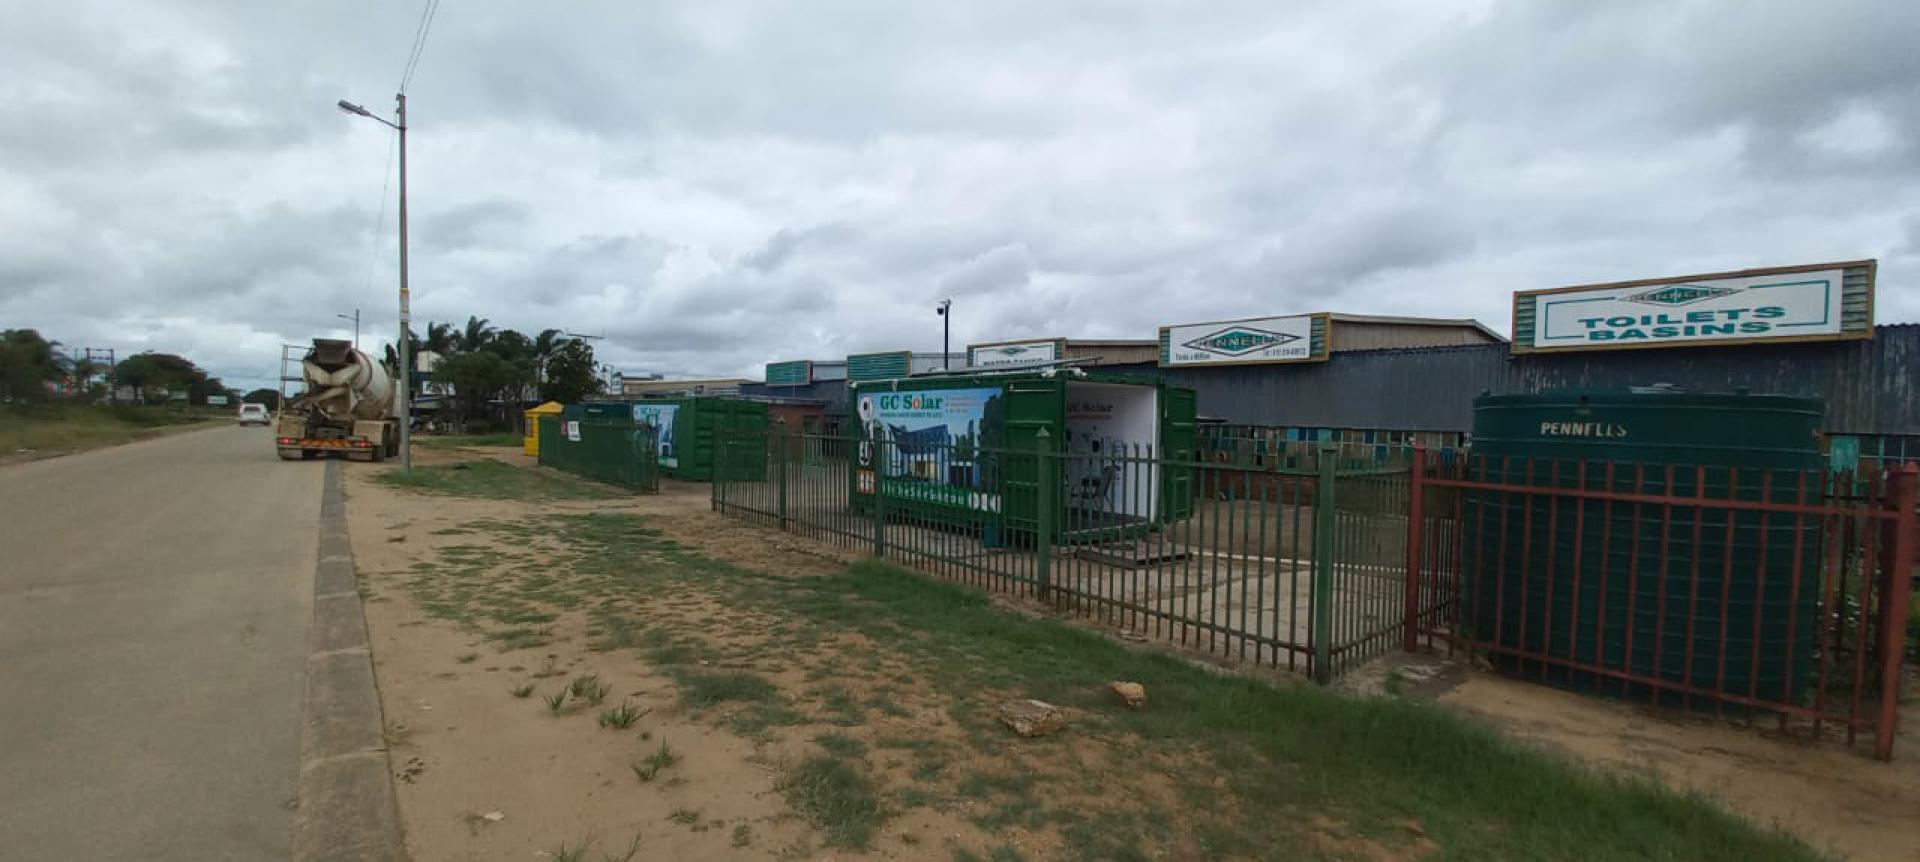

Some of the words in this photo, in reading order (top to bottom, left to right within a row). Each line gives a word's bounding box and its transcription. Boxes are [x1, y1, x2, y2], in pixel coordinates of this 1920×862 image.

[1578, 306, 1786, 329] TOILETS
[1589, 321, 1772, 341] BASINS
[880, 395, 899, 410] GC
[904, 393, 943, 410] Solar
